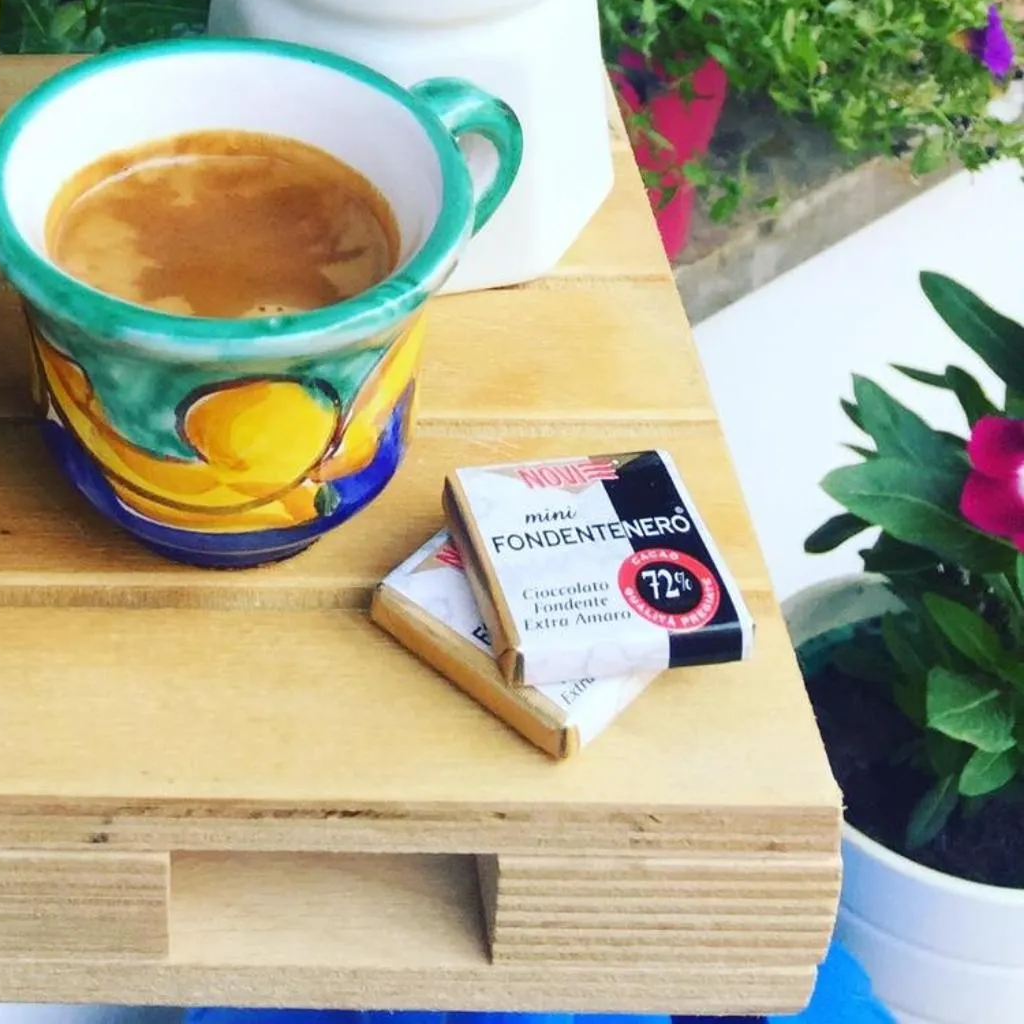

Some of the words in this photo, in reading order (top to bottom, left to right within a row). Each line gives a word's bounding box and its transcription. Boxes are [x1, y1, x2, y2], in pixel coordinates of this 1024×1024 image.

[525, 506, 577, 524] mini
[631, 551, 680, 566] CACAO
[522, 581, 609, 600] Cioccolato
[641, 568, 694, 600] 72%
[534, 596, 609, 614] Fondente
[523, 617, 569, 631] Extra
[576, 610, 632, 625] Amaro
